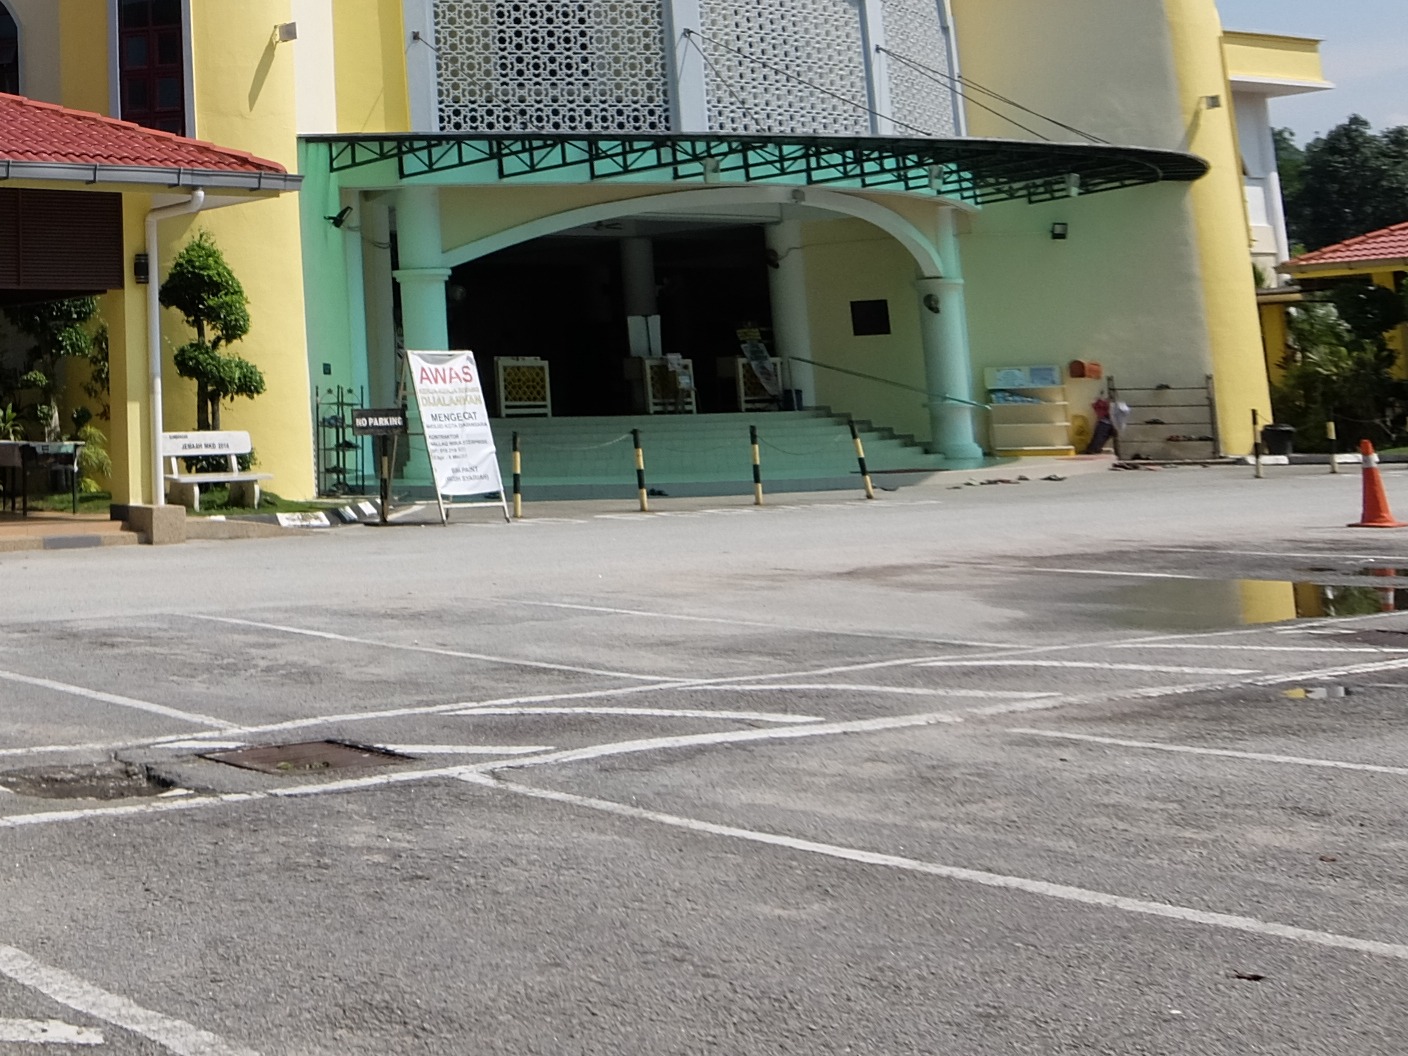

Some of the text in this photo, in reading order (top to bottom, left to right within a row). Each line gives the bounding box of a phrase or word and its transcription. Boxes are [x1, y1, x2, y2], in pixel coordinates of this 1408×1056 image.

[420, 365, 473, 384] AWAS
[356, 416, 403, 427] NO PARKING
[430, 411, 477, 422] MENGECAT
